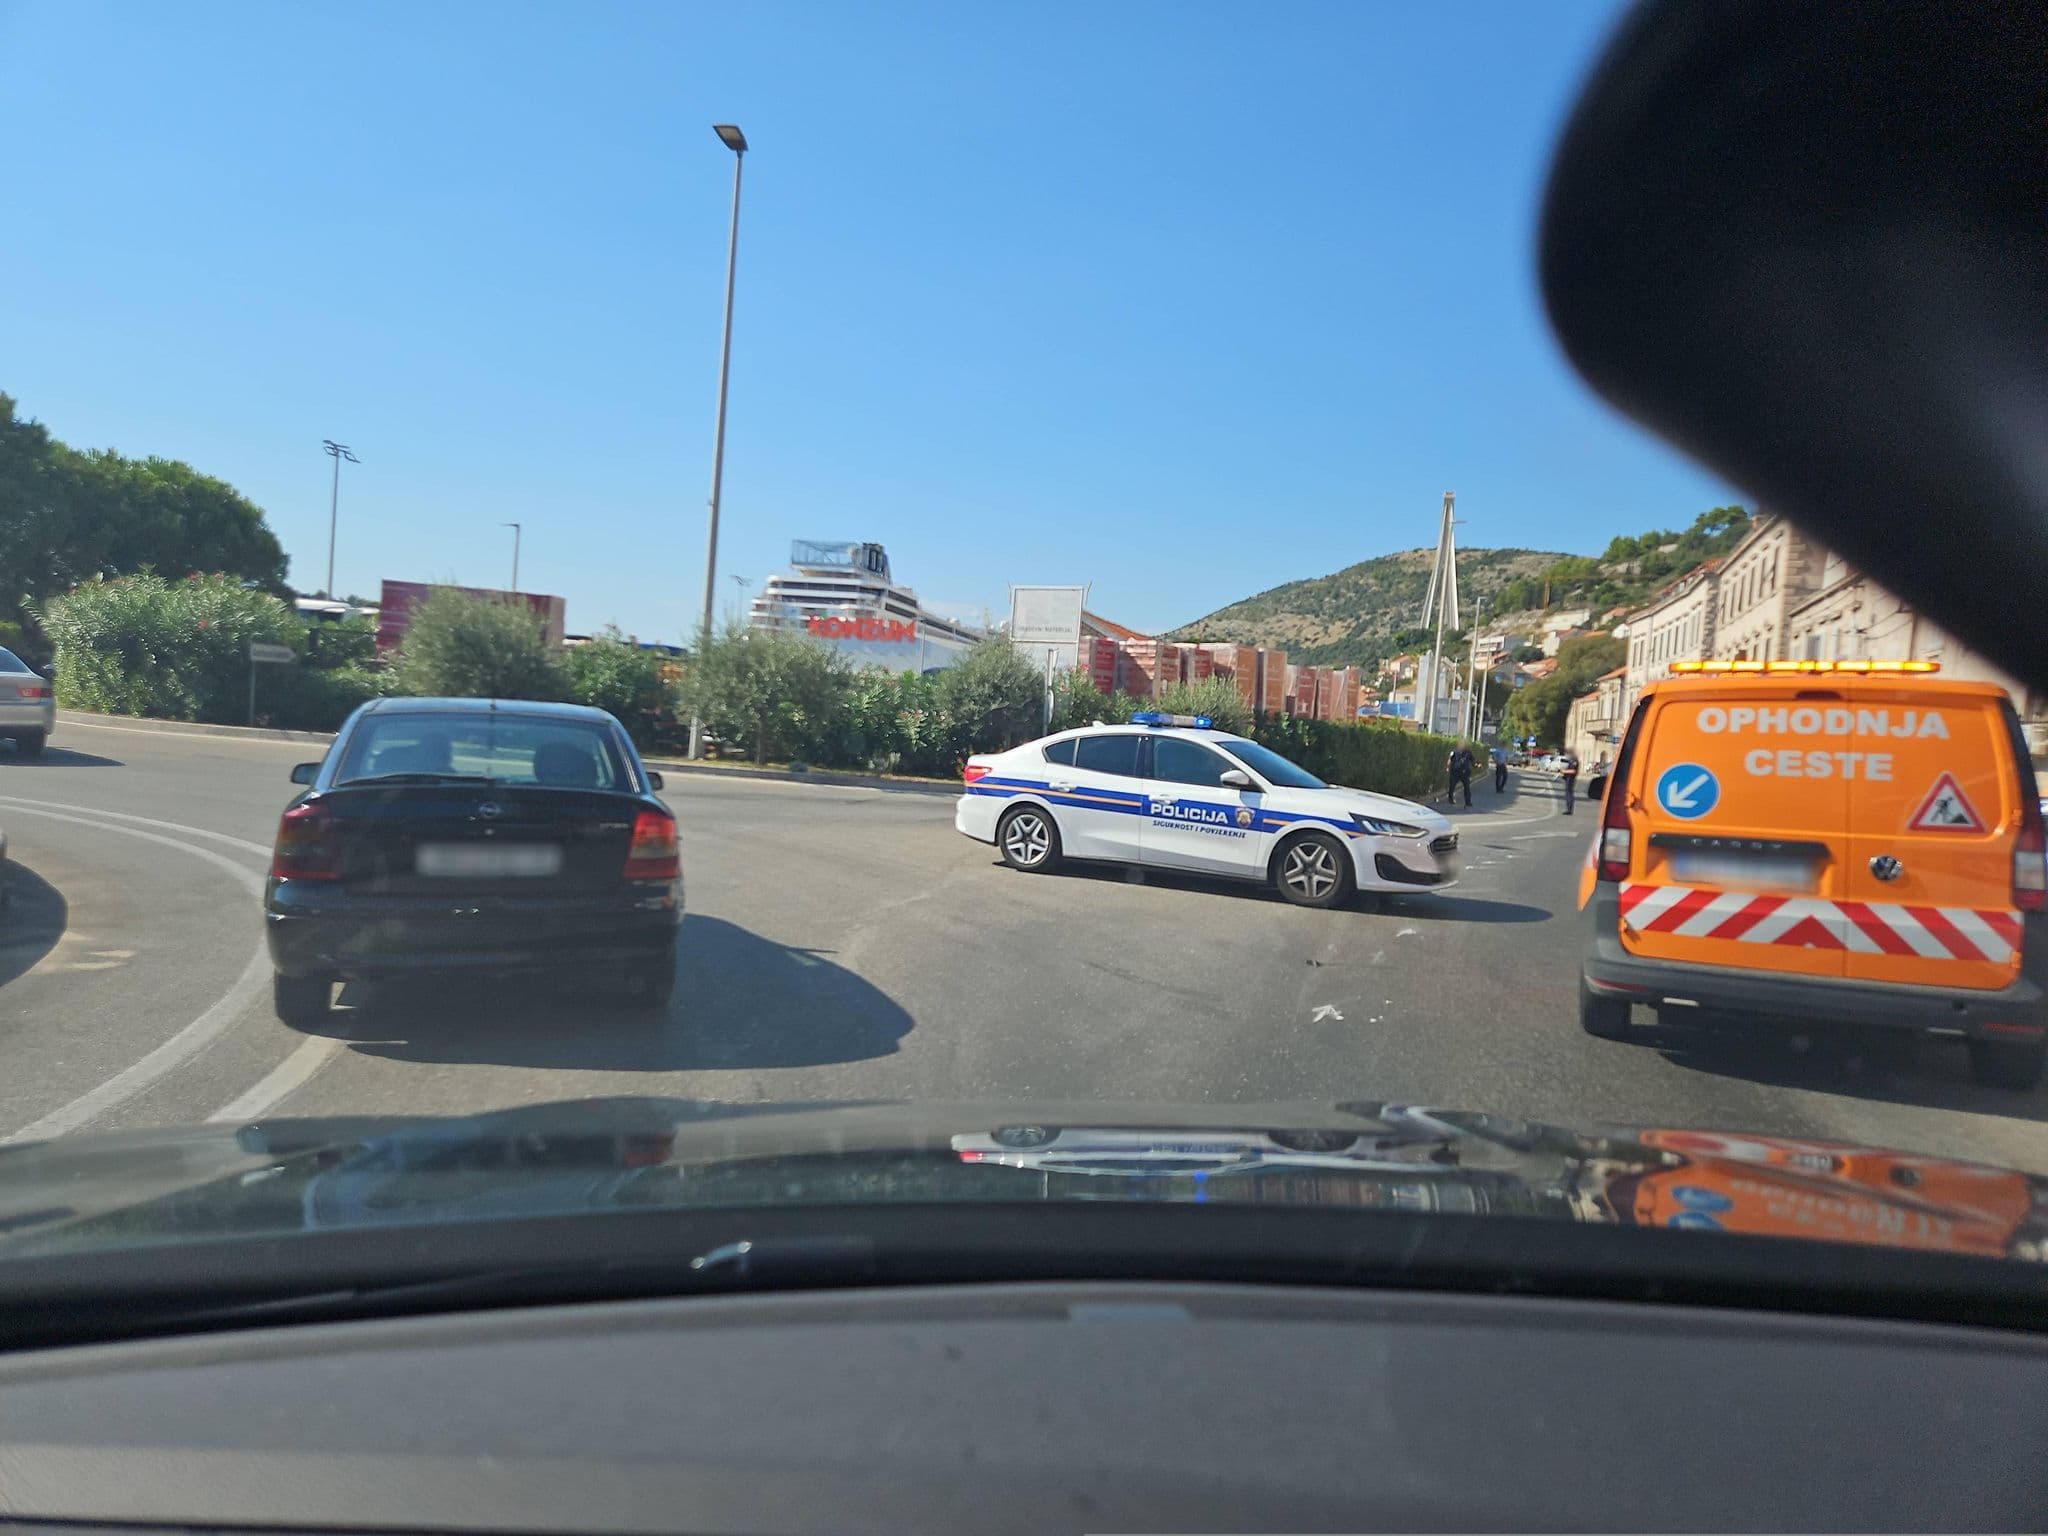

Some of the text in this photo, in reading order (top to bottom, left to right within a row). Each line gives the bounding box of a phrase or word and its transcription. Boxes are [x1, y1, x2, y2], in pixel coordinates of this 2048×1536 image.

[806, 615, 916, 643] KONZUM
[1696, 707, 1949, 740] OPHODNJA
[1744, 748, 1894, 781] CESTE
[1150, 802, 1229, 825] POLICIJA
[1153, 819, 1194, 832] SIGURNOST
